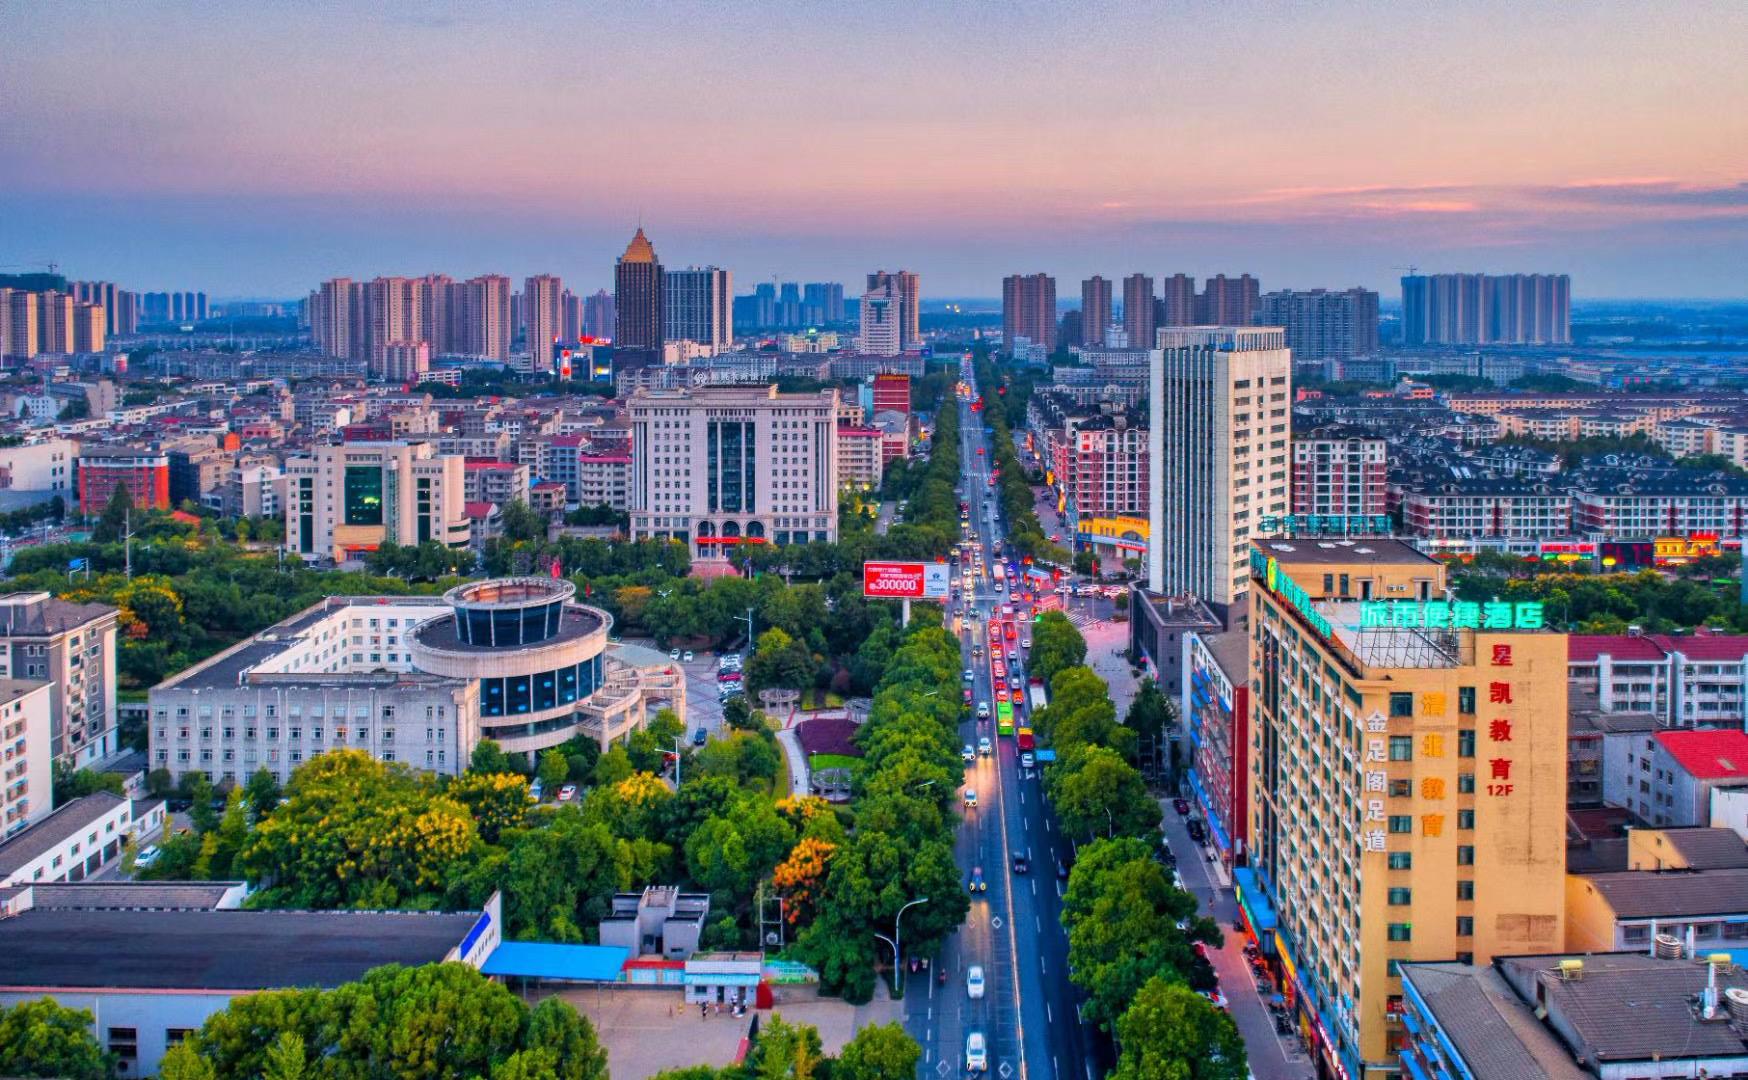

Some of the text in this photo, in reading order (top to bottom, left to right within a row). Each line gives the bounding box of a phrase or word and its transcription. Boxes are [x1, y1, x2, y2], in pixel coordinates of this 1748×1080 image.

[876, 579, 916, 591] 300000
[1360, 601, 1545, 628] 城市便捷酒店
[1489, 644, 1513, 780] 星凯教育
[1364, 709, 1388, 853] 金足阁足道
[1487, 784, 1514, 797] 12F
